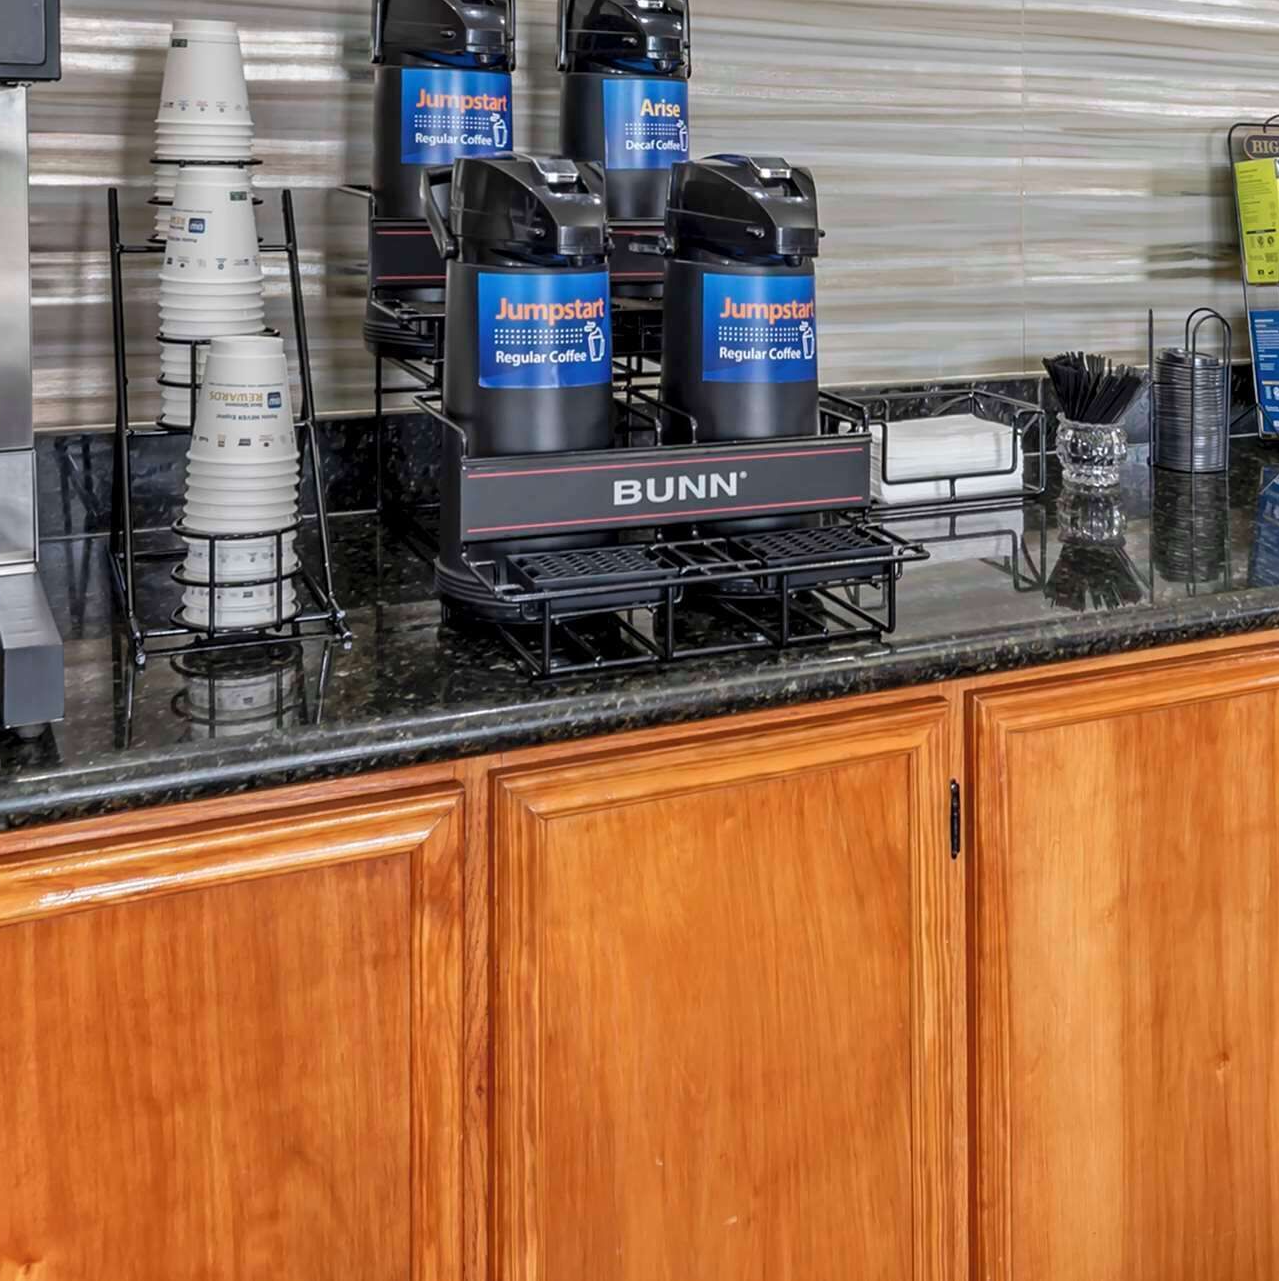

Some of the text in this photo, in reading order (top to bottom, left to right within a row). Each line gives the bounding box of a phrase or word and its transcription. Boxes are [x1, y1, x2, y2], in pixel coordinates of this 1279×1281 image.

[415, 88, 508, 113] Jumpstart
[639, 98, 681, 118] Arise
[415, 132, 493, 147] Regular Coffee
[625, 138, 681, 152] Decaf Coffee
[495, 297, 605, 326] Jumpstart
[719, 297, 815, 324] Jumpstart
[495, 349, 587, 367] Regular Coffee
[719, 346, 802, 364] Regular Coffee
[208, 391, 264, 402] REWARDS
[613, 471, 738, 506] BUNN
